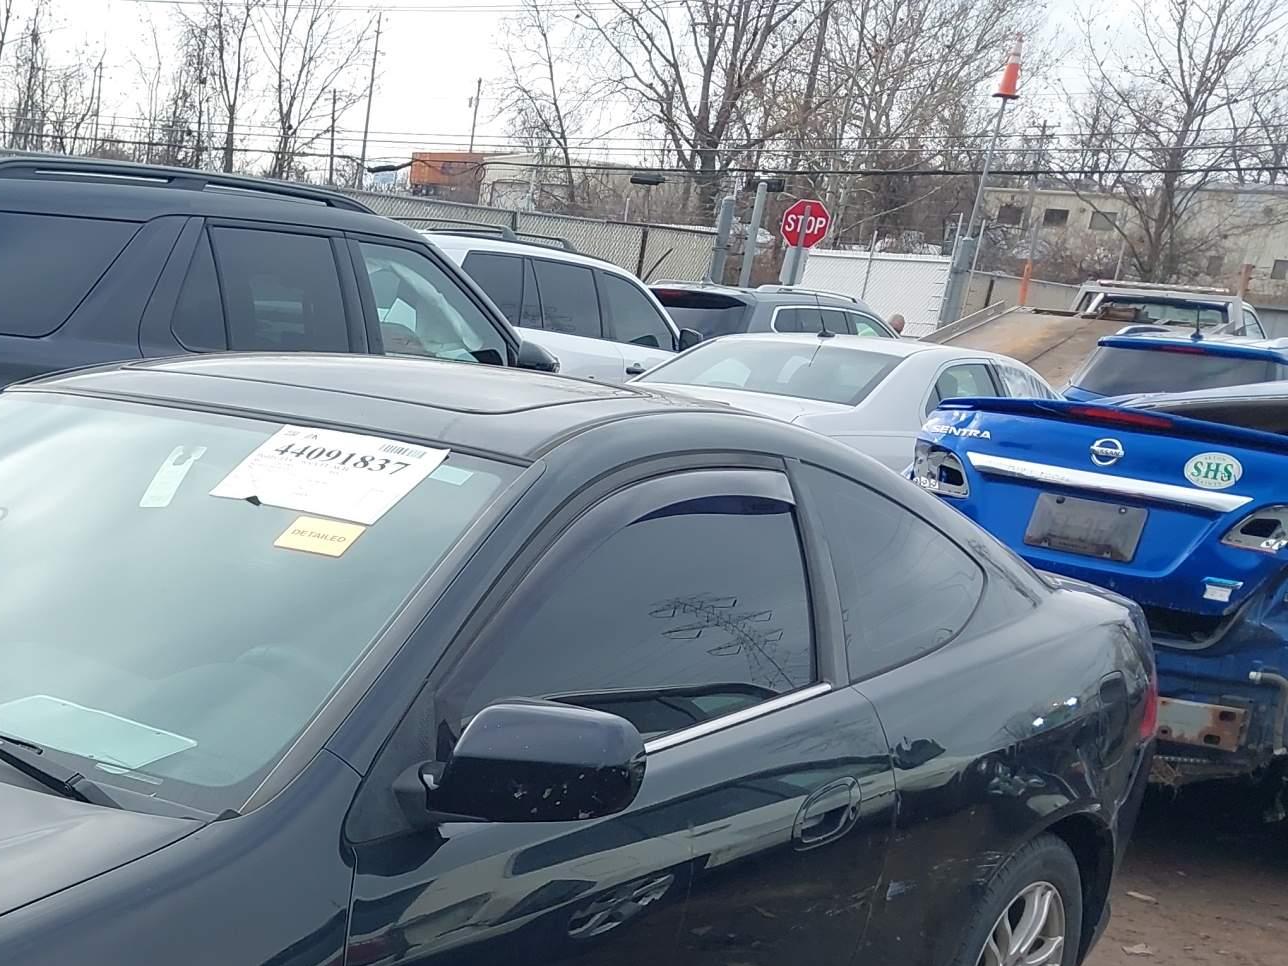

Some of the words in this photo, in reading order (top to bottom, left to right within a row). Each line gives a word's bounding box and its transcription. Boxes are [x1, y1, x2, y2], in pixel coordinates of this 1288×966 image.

[784, 214, 826, 234] STOP
[932, 425, 991, 440] SENTRA
[274, 442, 412, 475] 44091837
[1094, 449, 1122, 457] NISSAN
[1191, 460, 1234, 482] SHS
[291, 527, 347, 544] DETAILED
